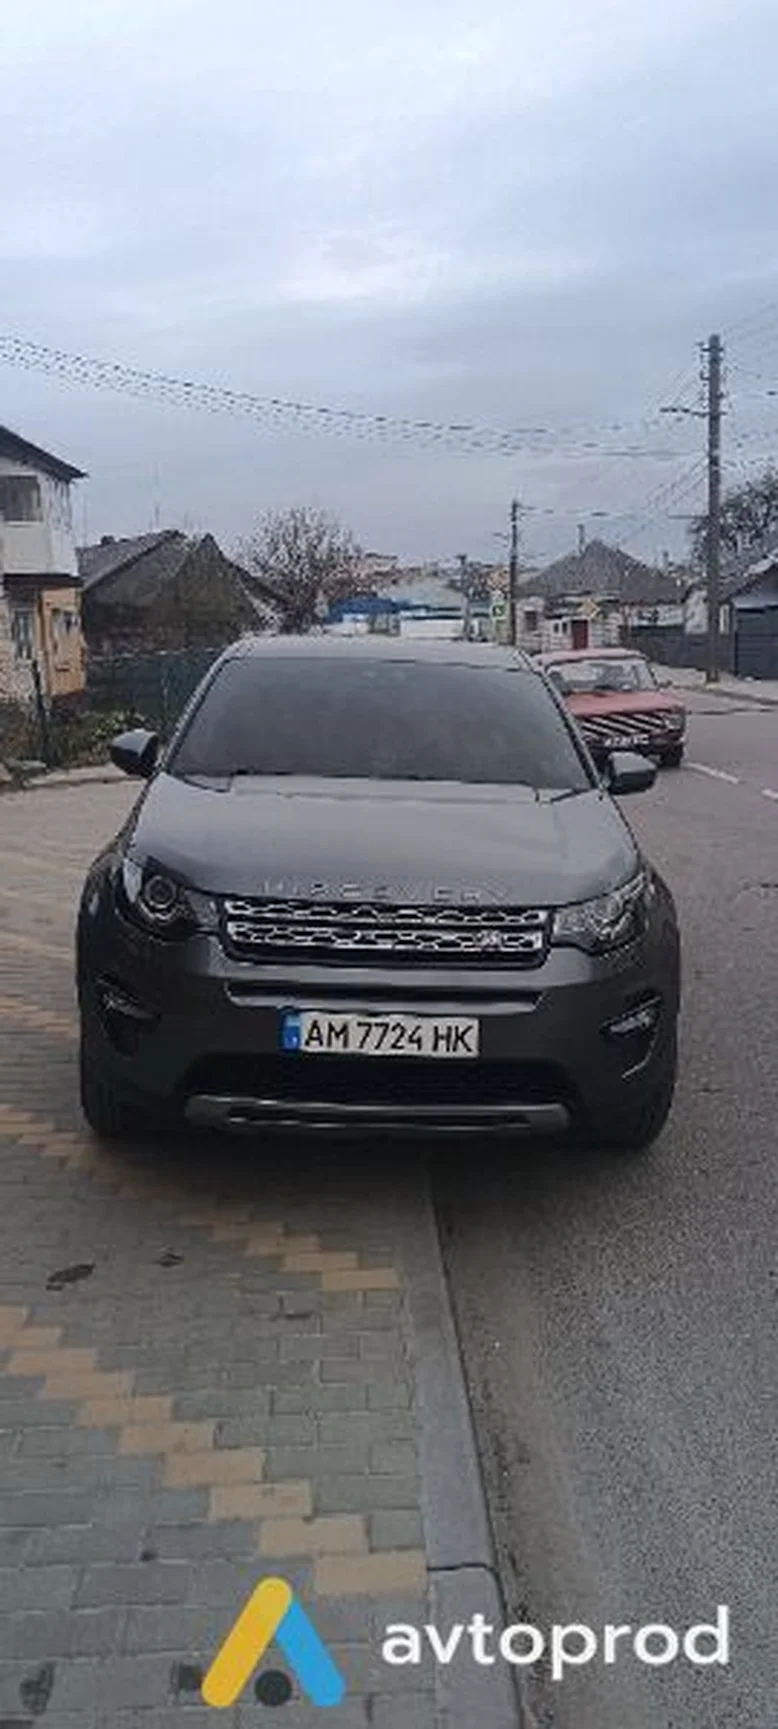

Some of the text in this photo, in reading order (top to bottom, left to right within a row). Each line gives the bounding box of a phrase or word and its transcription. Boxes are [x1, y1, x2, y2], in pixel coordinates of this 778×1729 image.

[305, 1019, 475, 1053] AM 7724 HK
